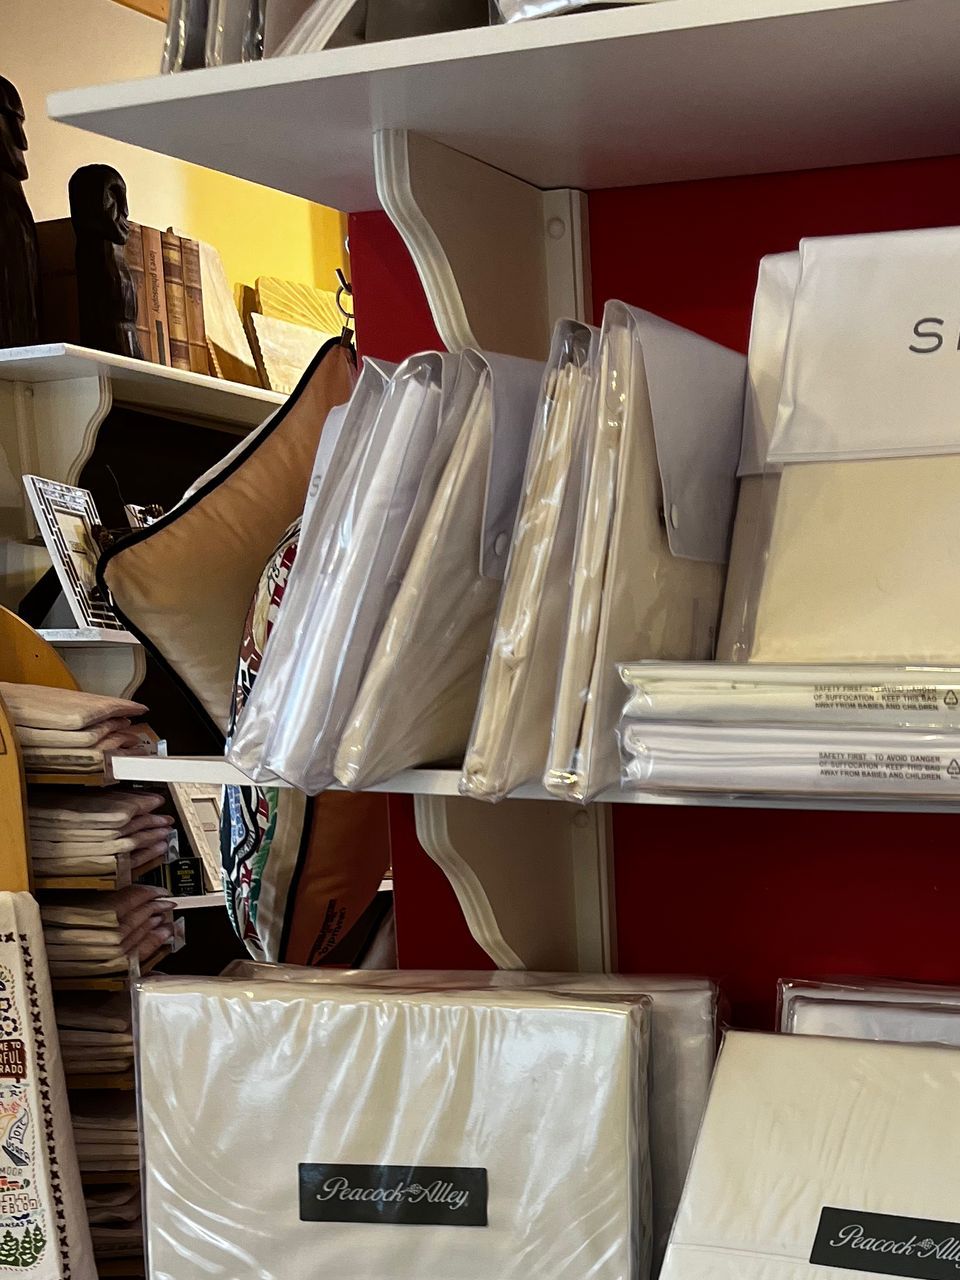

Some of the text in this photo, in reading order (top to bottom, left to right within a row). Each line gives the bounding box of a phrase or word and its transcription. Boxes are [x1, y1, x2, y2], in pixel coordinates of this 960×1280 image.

[819, 752, 845, 760] SAFETY
[830, 761, 878, 769] SUFFOCATION
[862, 771, 887, 779] BABIES
[889, 772, 904, 780] AND
[905, 773, 941, 781] CHILDREN
[316, 1176, 469, 1210] Peacock Alley
[829, 1224, 917, 1255] Peacock
